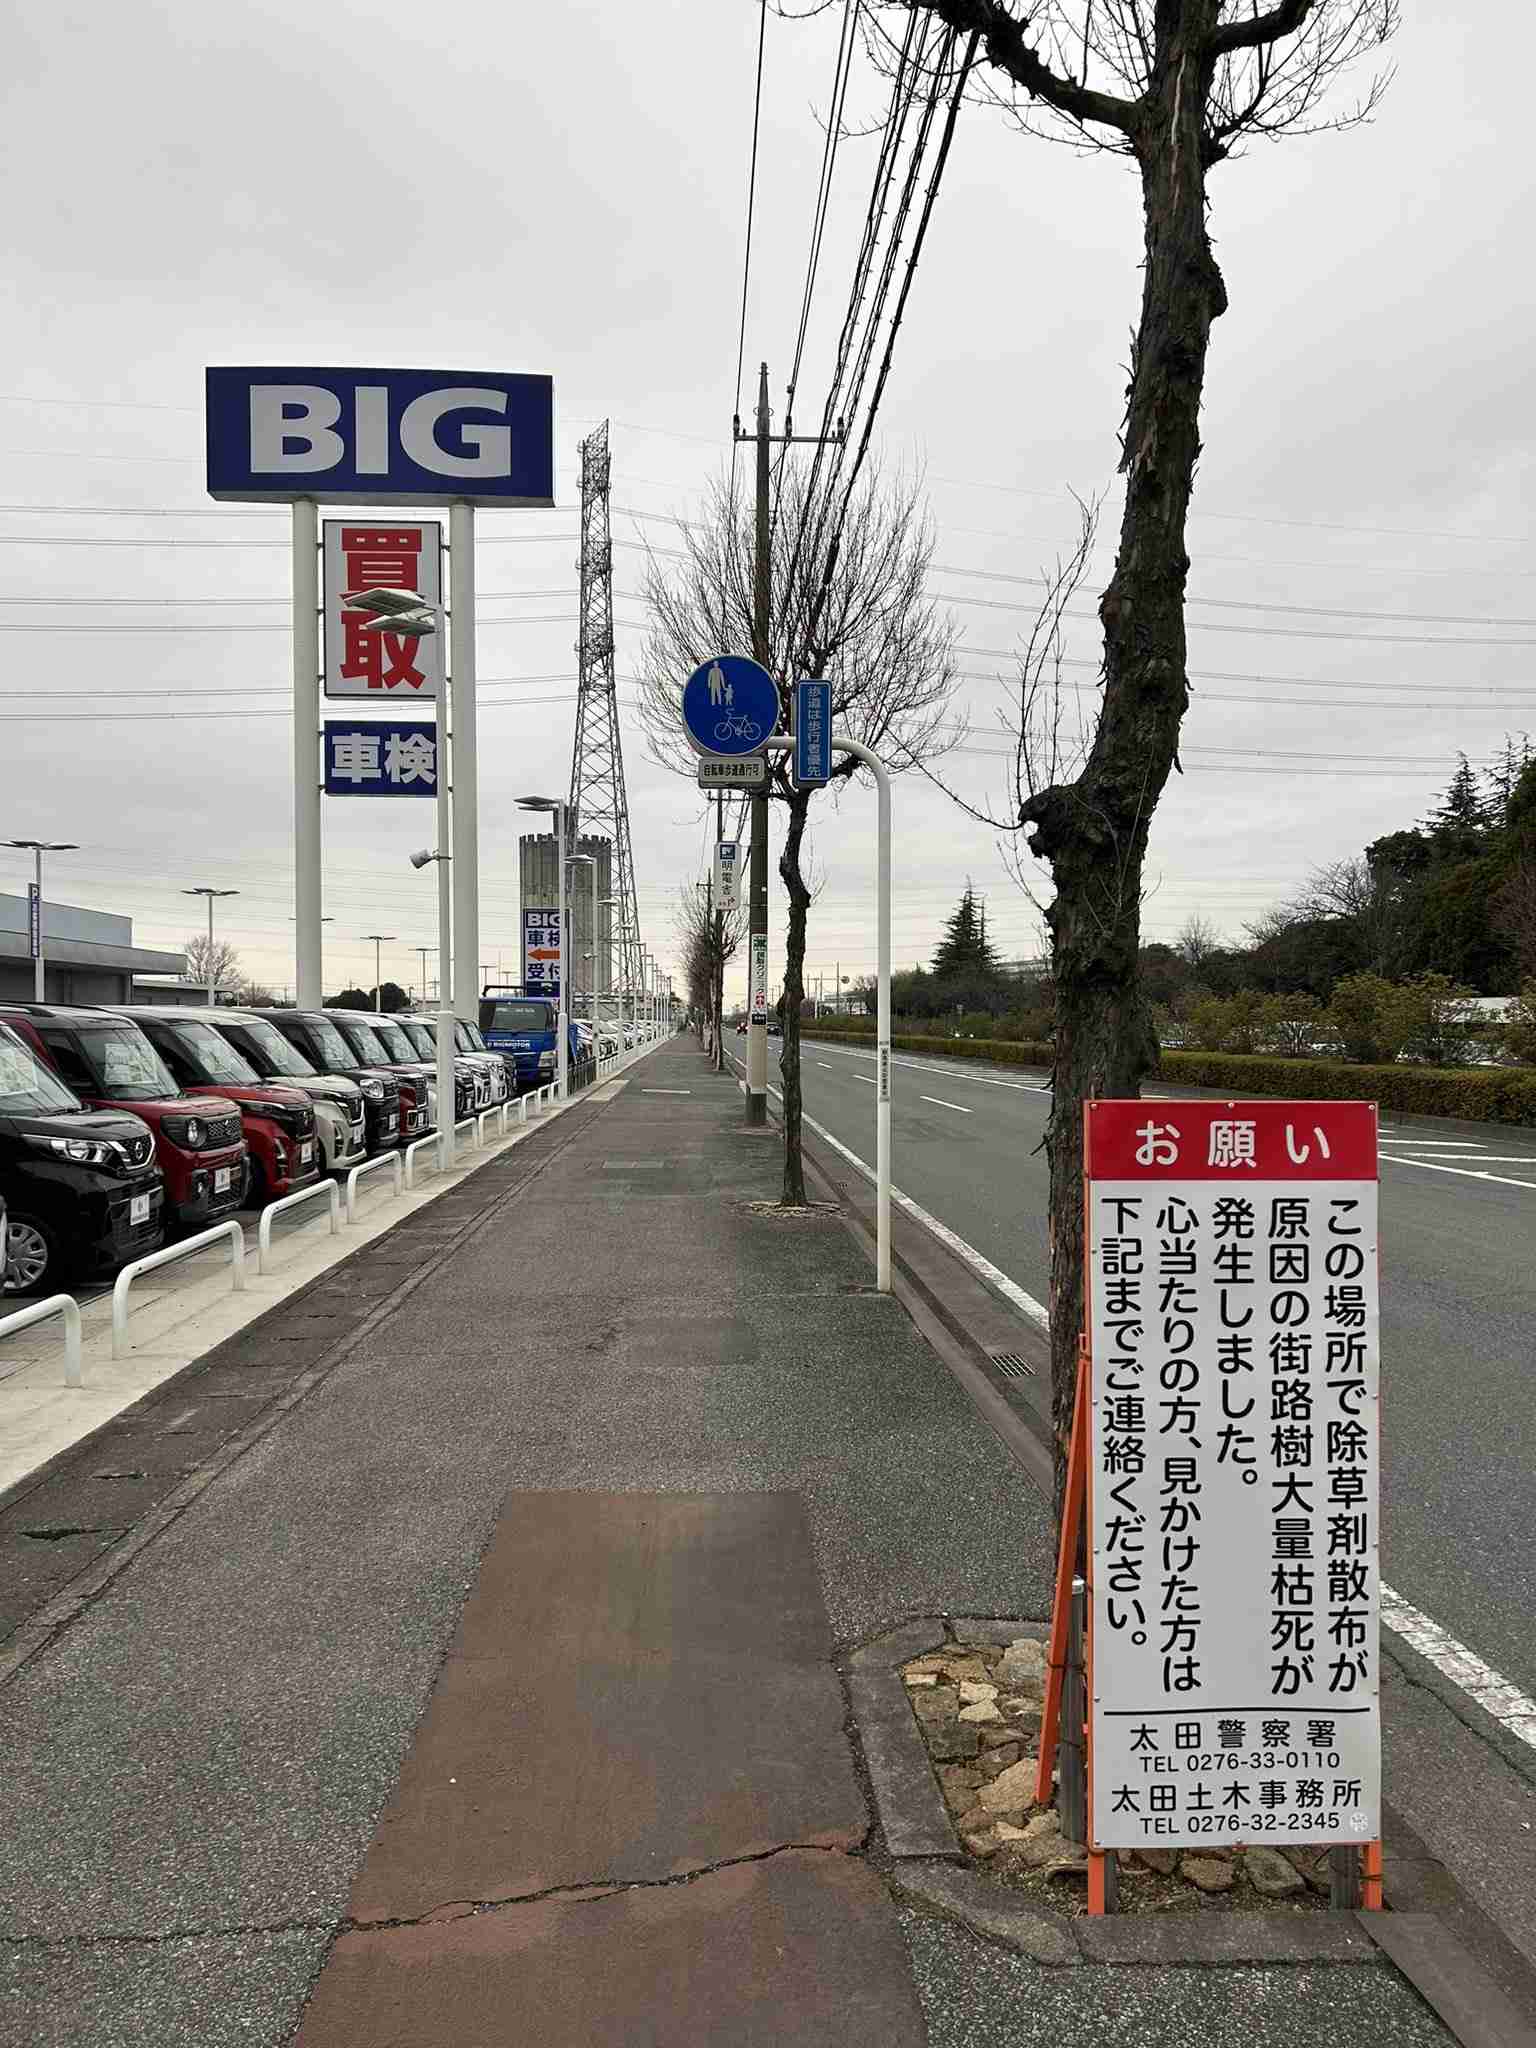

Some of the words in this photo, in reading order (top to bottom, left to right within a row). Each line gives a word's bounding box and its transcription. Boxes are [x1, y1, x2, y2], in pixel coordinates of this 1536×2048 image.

[249, 385, 511, 478] BIG
[340, 528, 426, 689] 買取
[332, 733, 436, 784] 車検
[1134, 1119, 1331, 1168] お願い
[1212, 1197, 1259, 1486] 発生しました。
[1101, 1198, 1148, 1646] 下記までご連絡ください。
[1156, 1197, 1202, 1694] 心当たりの方、見かけた方は
[1268, 1198, 1315, 1696] 原因の街路樹大量枯死が
[1324, 1199, 1370, 1694] この場所で除草剤散布が
[1130, 1719, 1337, 1752] 太田警察署
[1140, 1756, 1179, 1773] TEL
[1187, 1752, 1341, 1773] 0276-33-0110
[1112, 1779, 1363, 1813] 太田土木事務所
[1140, 1817, 1179, 1834] TEL
[1187, 1813, 1341, 1834] 0276-32-2345
